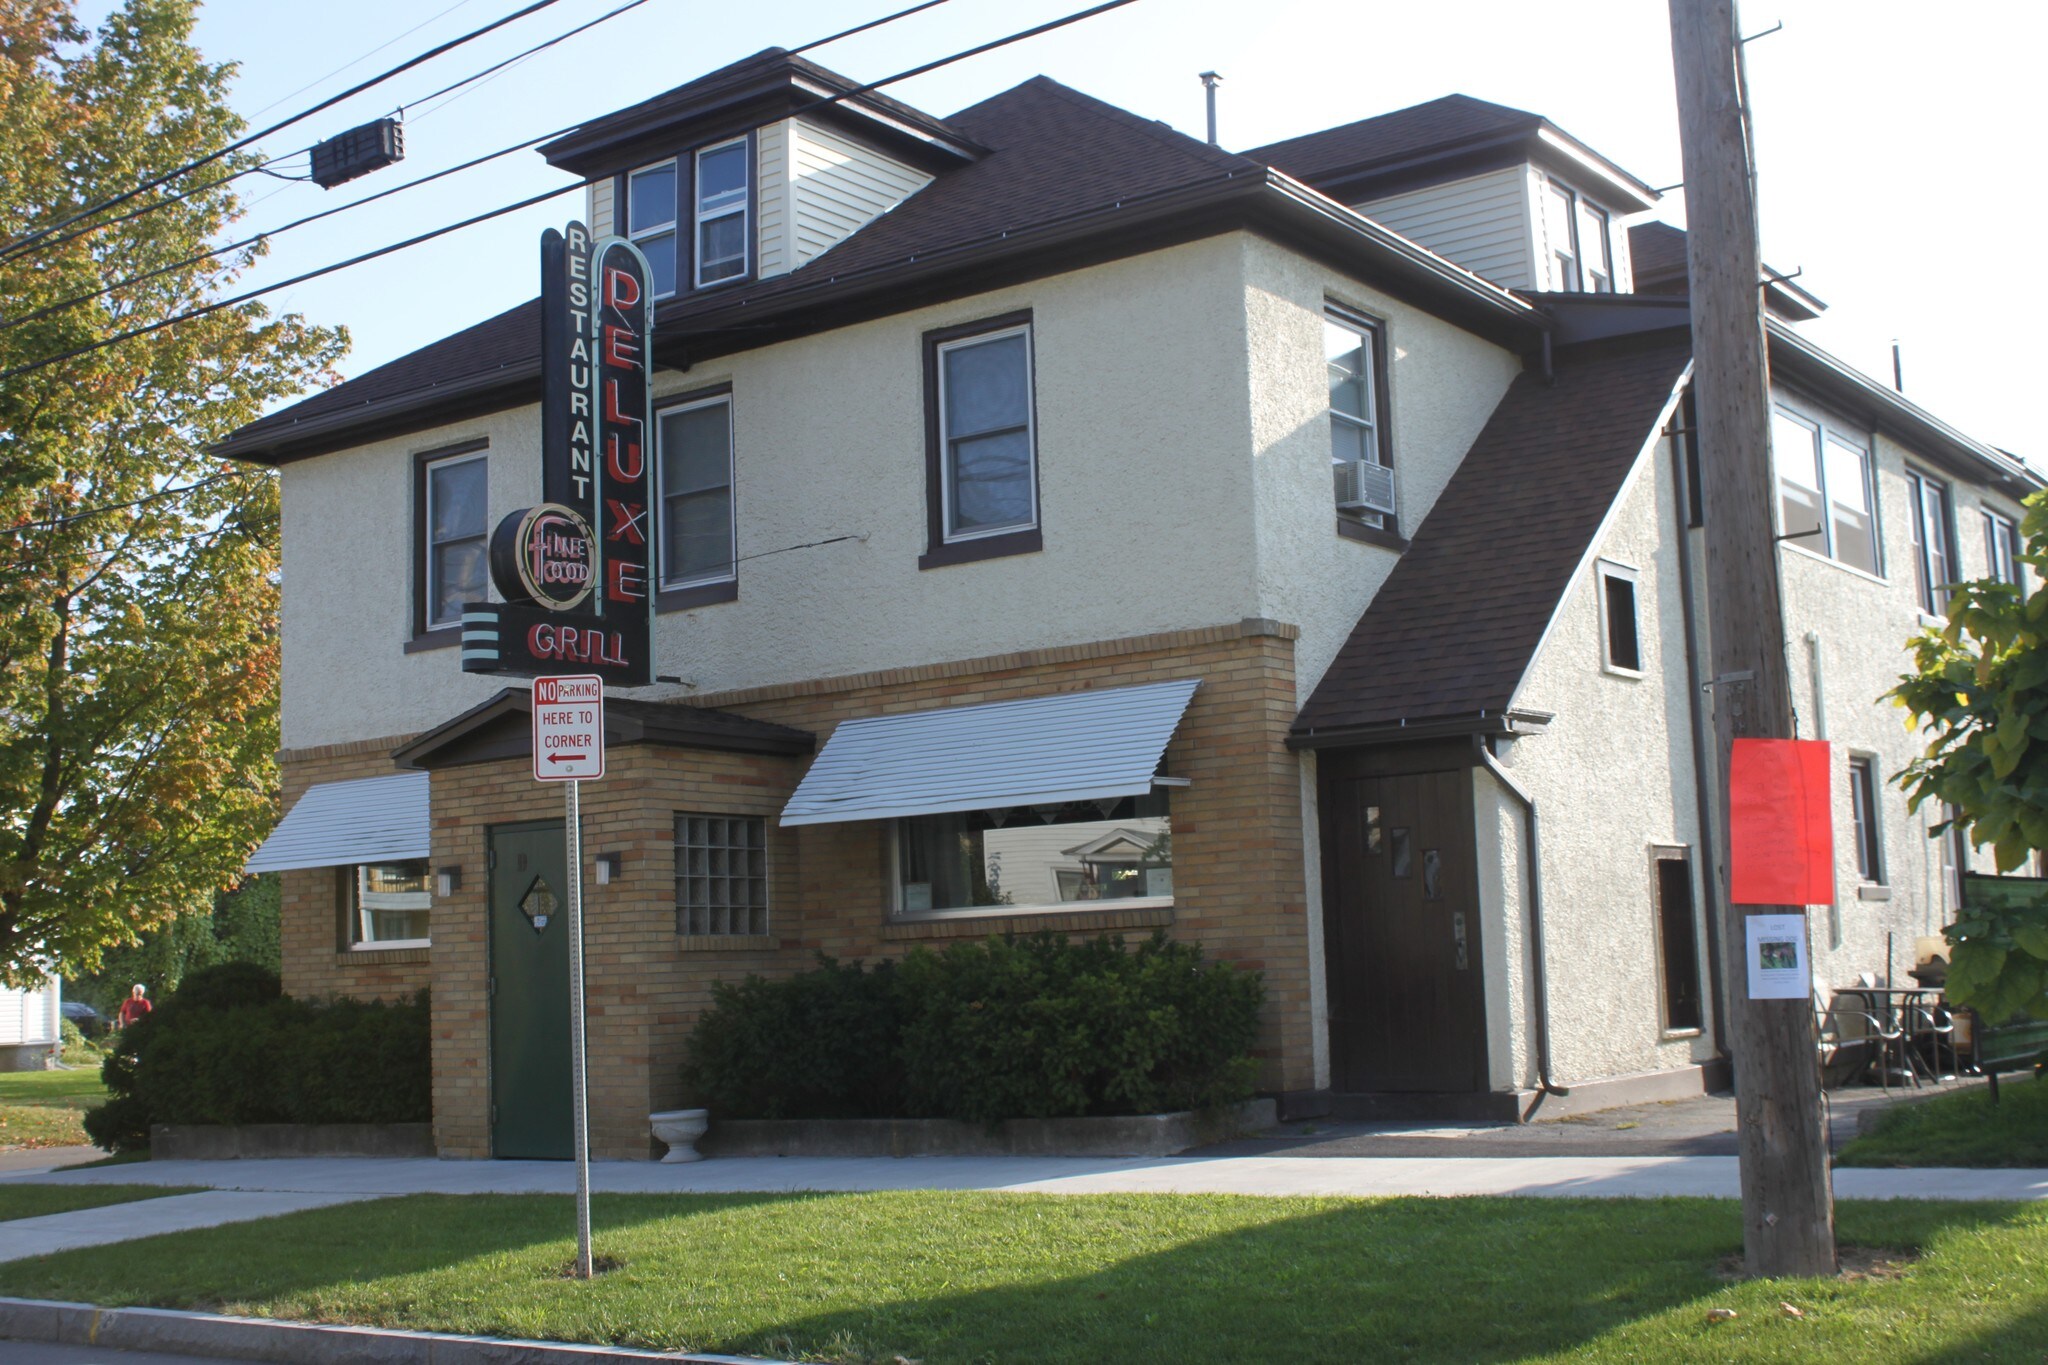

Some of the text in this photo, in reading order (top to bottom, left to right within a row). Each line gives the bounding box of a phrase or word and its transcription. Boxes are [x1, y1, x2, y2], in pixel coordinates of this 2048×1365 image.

[568, 227, 590, 500] RESTAURANT
[604, 267, 648, 604] DELUXE
[527, 622, 629, 668] GRILL
[538, 681, 598, 702] NO PARKING
[543, 710, 593, 725] HERE TO
[544, 734, 592, 749] CORNER
